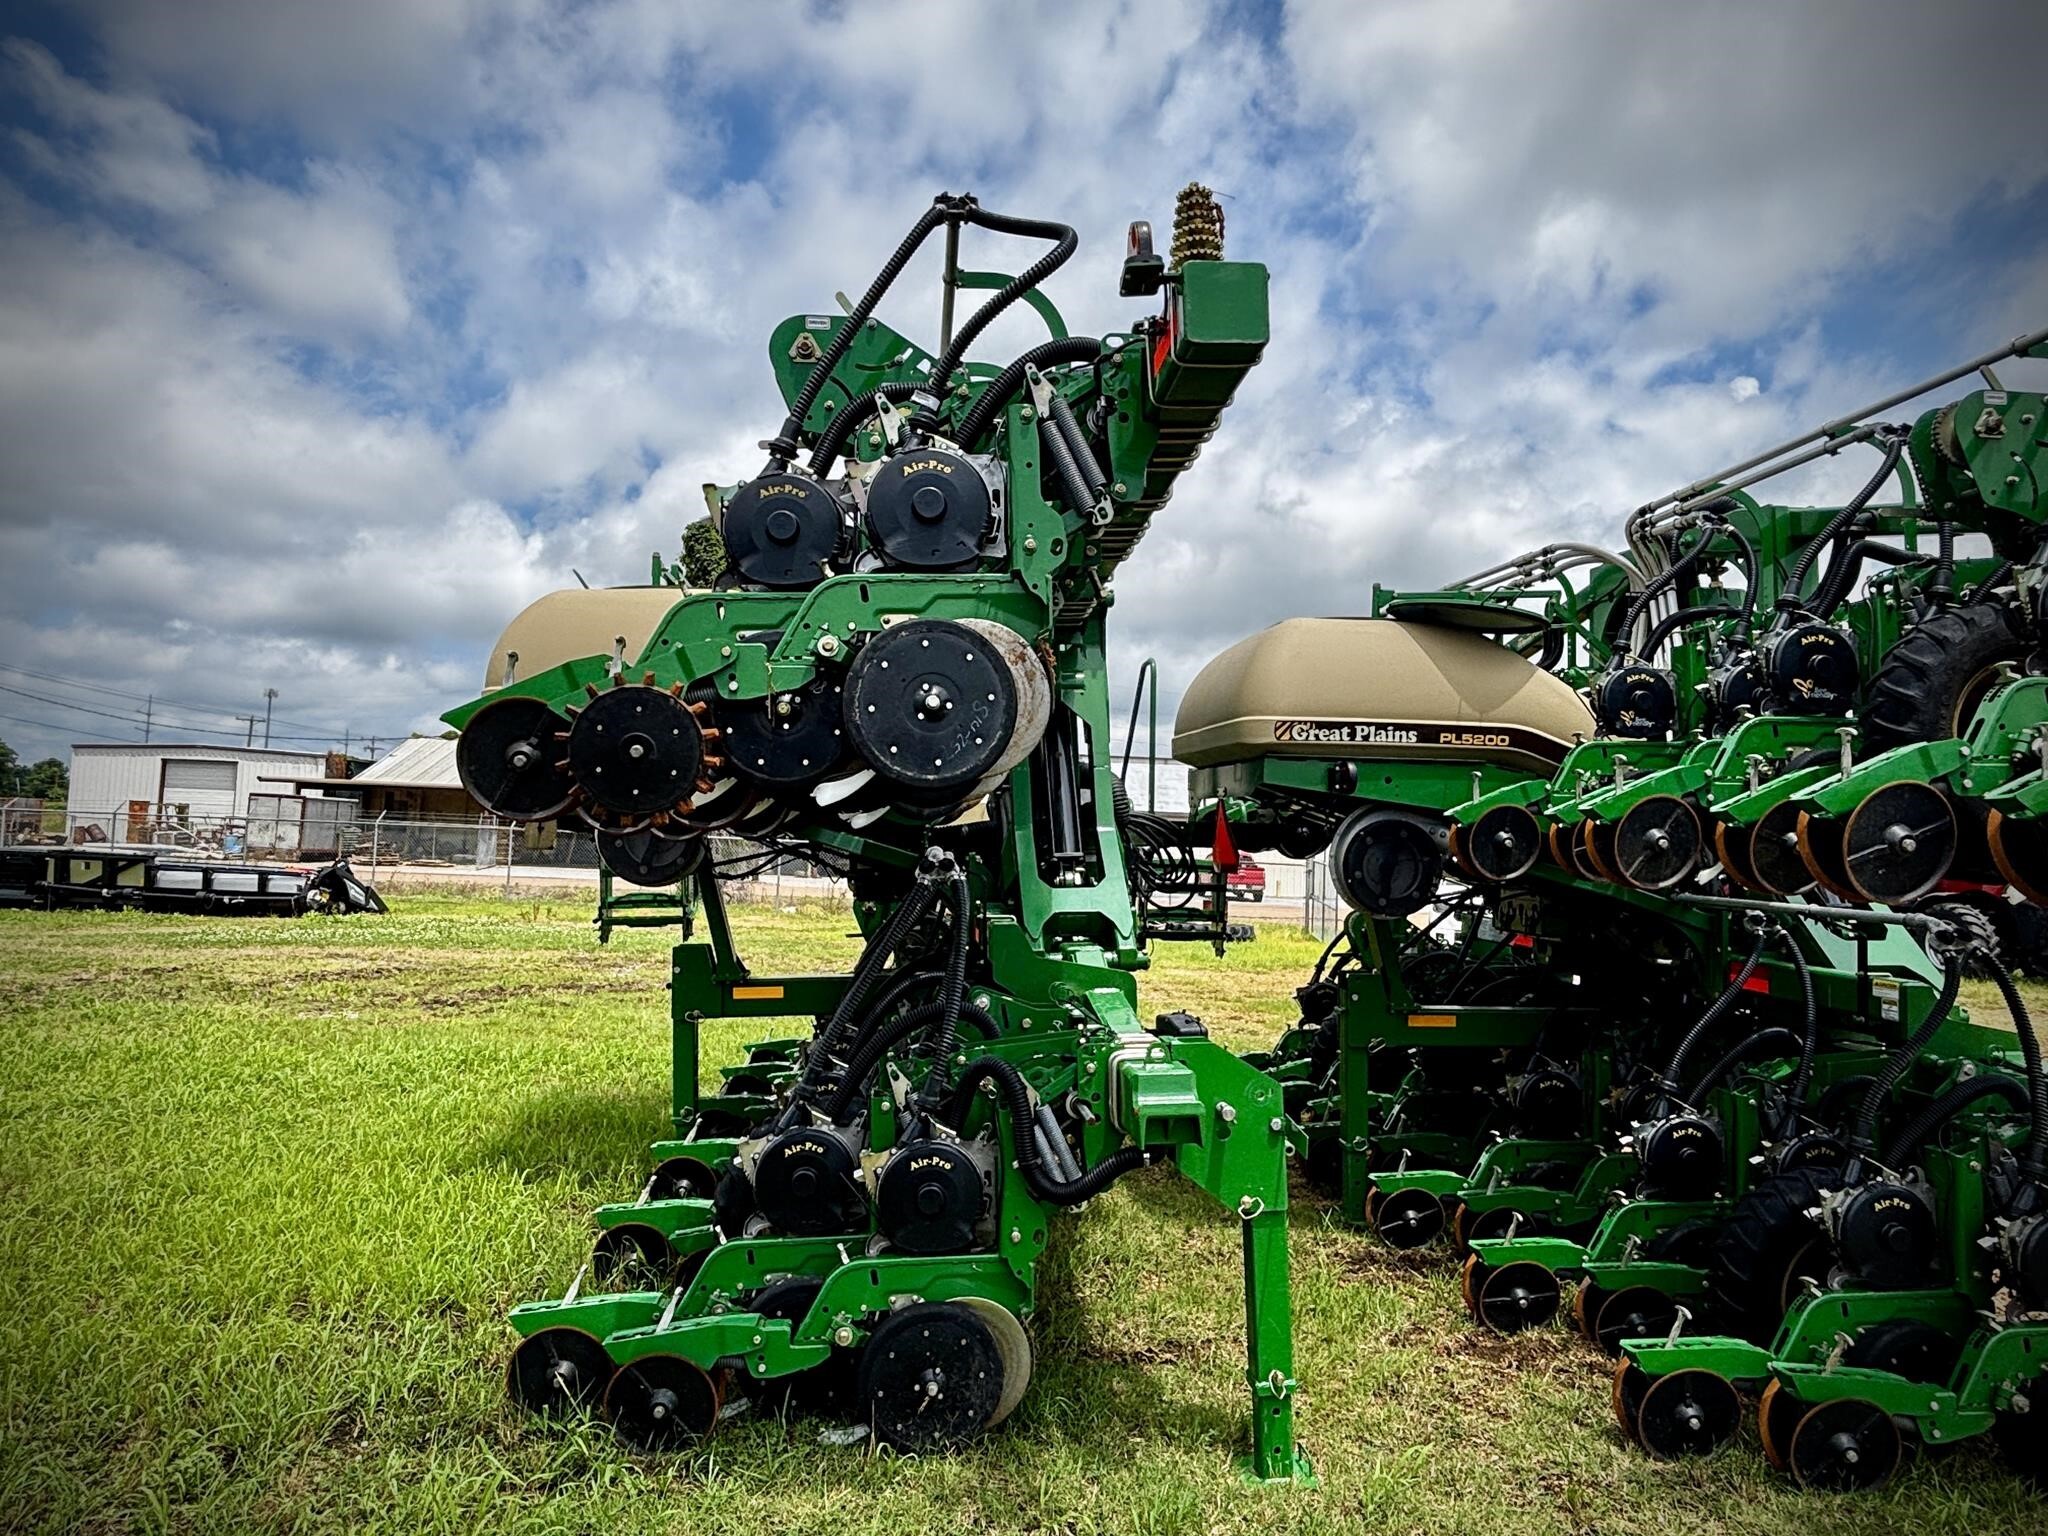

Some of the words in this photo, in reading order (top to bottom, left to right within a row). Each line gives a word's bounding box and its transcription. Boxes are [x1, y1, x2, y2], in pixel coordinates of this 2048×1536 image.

[1291, 723, 1351, 742] Great
[1354, 725, 1417, 743] Plains
[1439, 732, 1510, 747] PL5200
